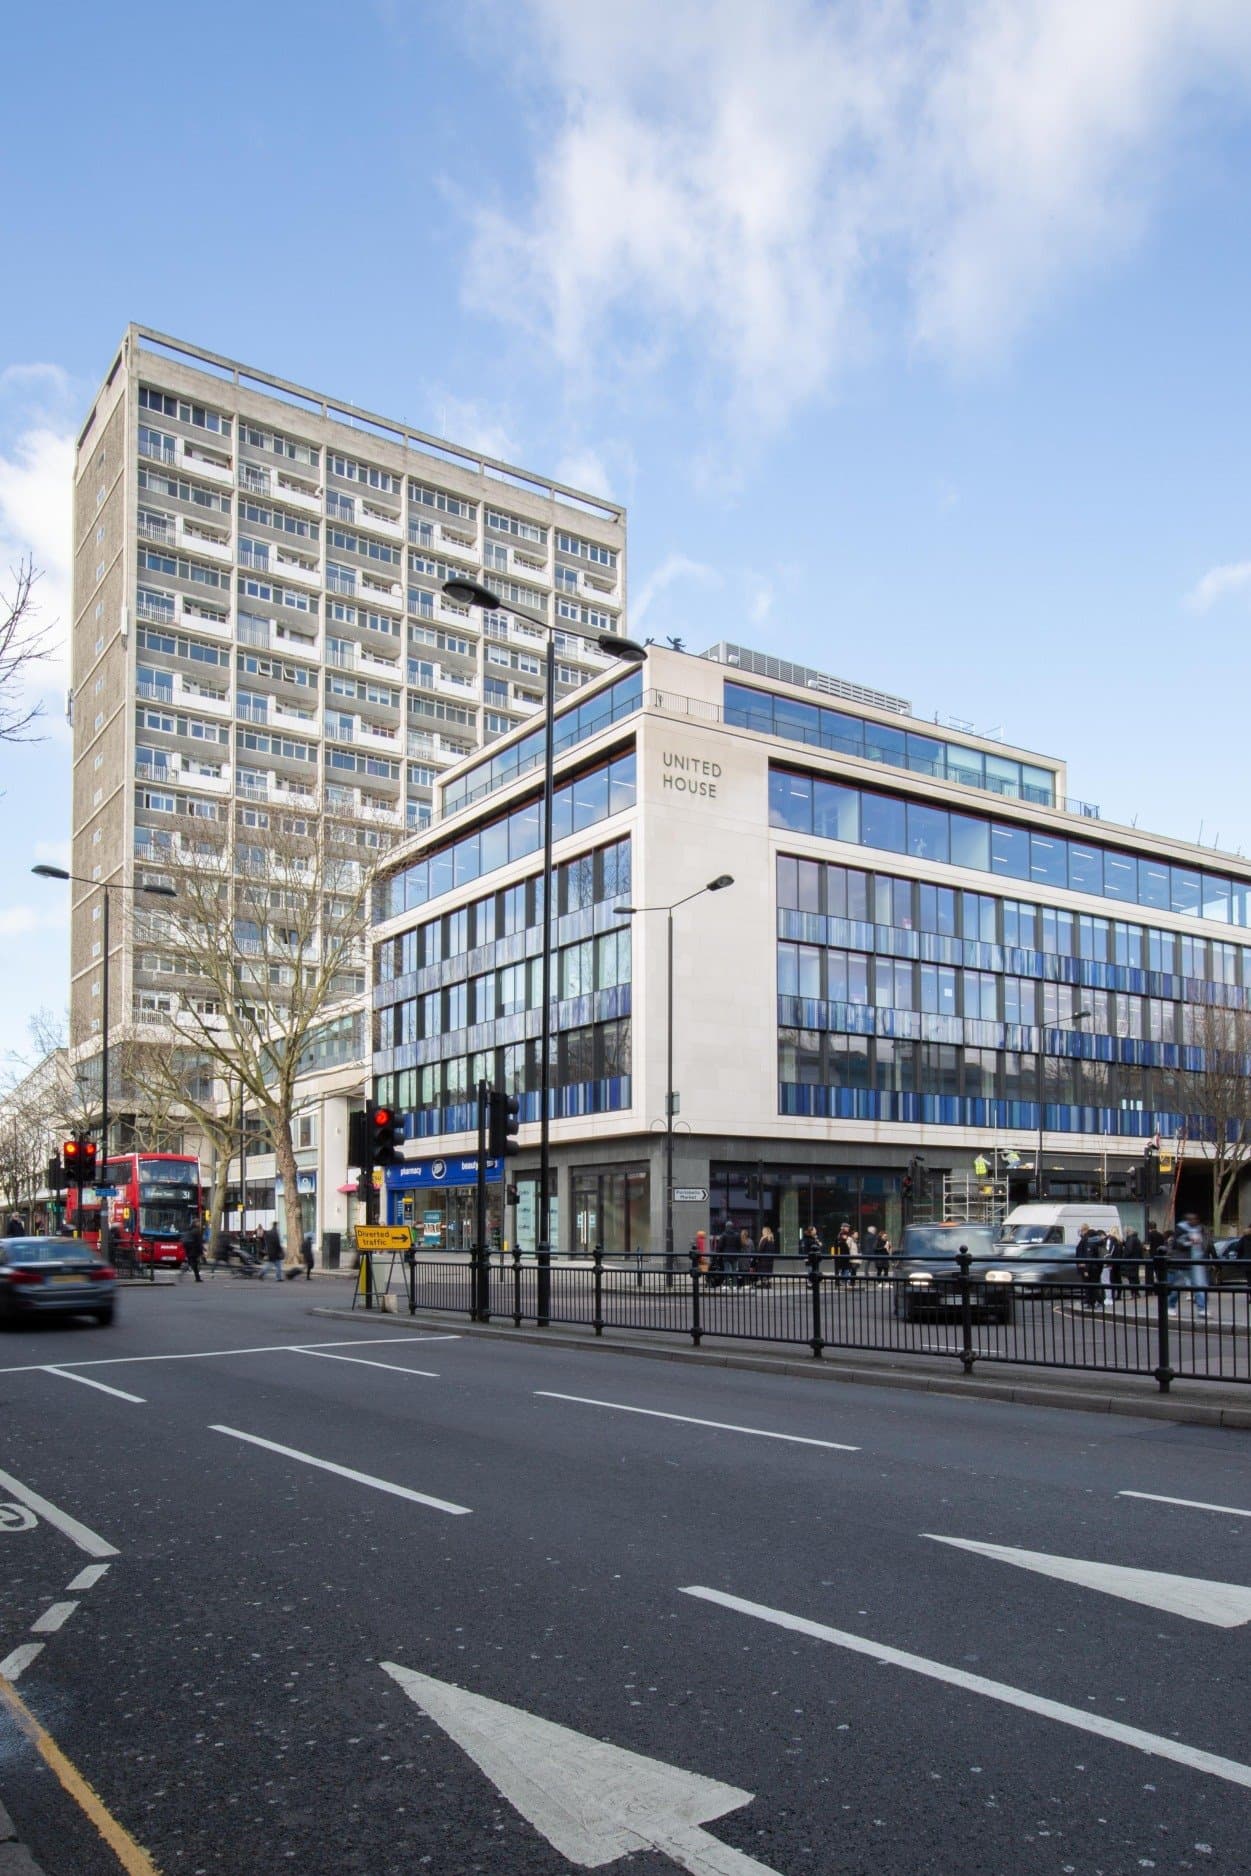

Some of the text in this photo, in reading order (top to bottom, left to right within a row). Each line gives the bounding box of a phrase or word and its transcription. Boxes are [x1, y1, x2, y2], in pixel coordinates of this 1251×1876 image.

[663, 751, 722, 778] UNITED
[663, 773, 717, 799] HOUSE
[400, 1167, 421, 1176] pharmacy
[182, 1190, 191, 1199] 31
[357, 1230, 390, 1238] Diverted
